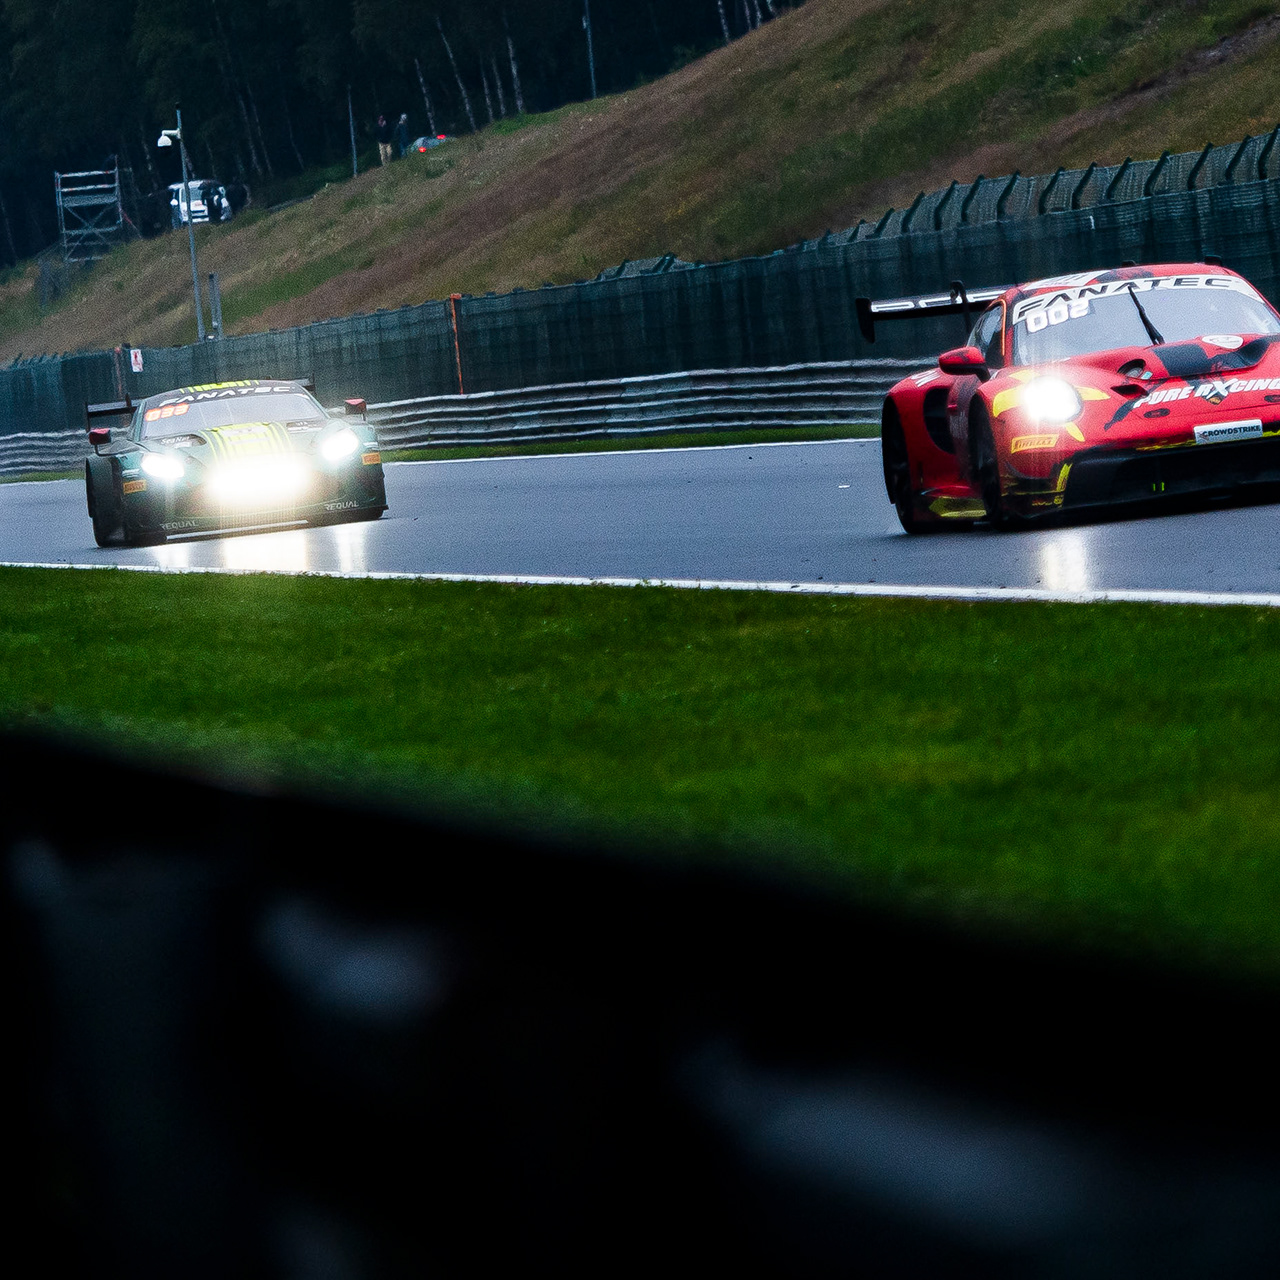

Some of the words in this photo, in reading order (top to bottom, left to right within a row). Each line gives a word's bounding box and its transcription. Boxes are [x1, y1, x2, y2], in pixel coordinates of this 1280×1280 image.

[1017, 277, 1233, 319] FANATEC
[1024, 298, 1090, 334] 002
[158, 386, 291, 407] FANATEC
[1133, 385, 1195, 408] PURE
[144, 402, 190, 422] 033
[1203, 425, 1261, 437] CROWDSTRIKE
